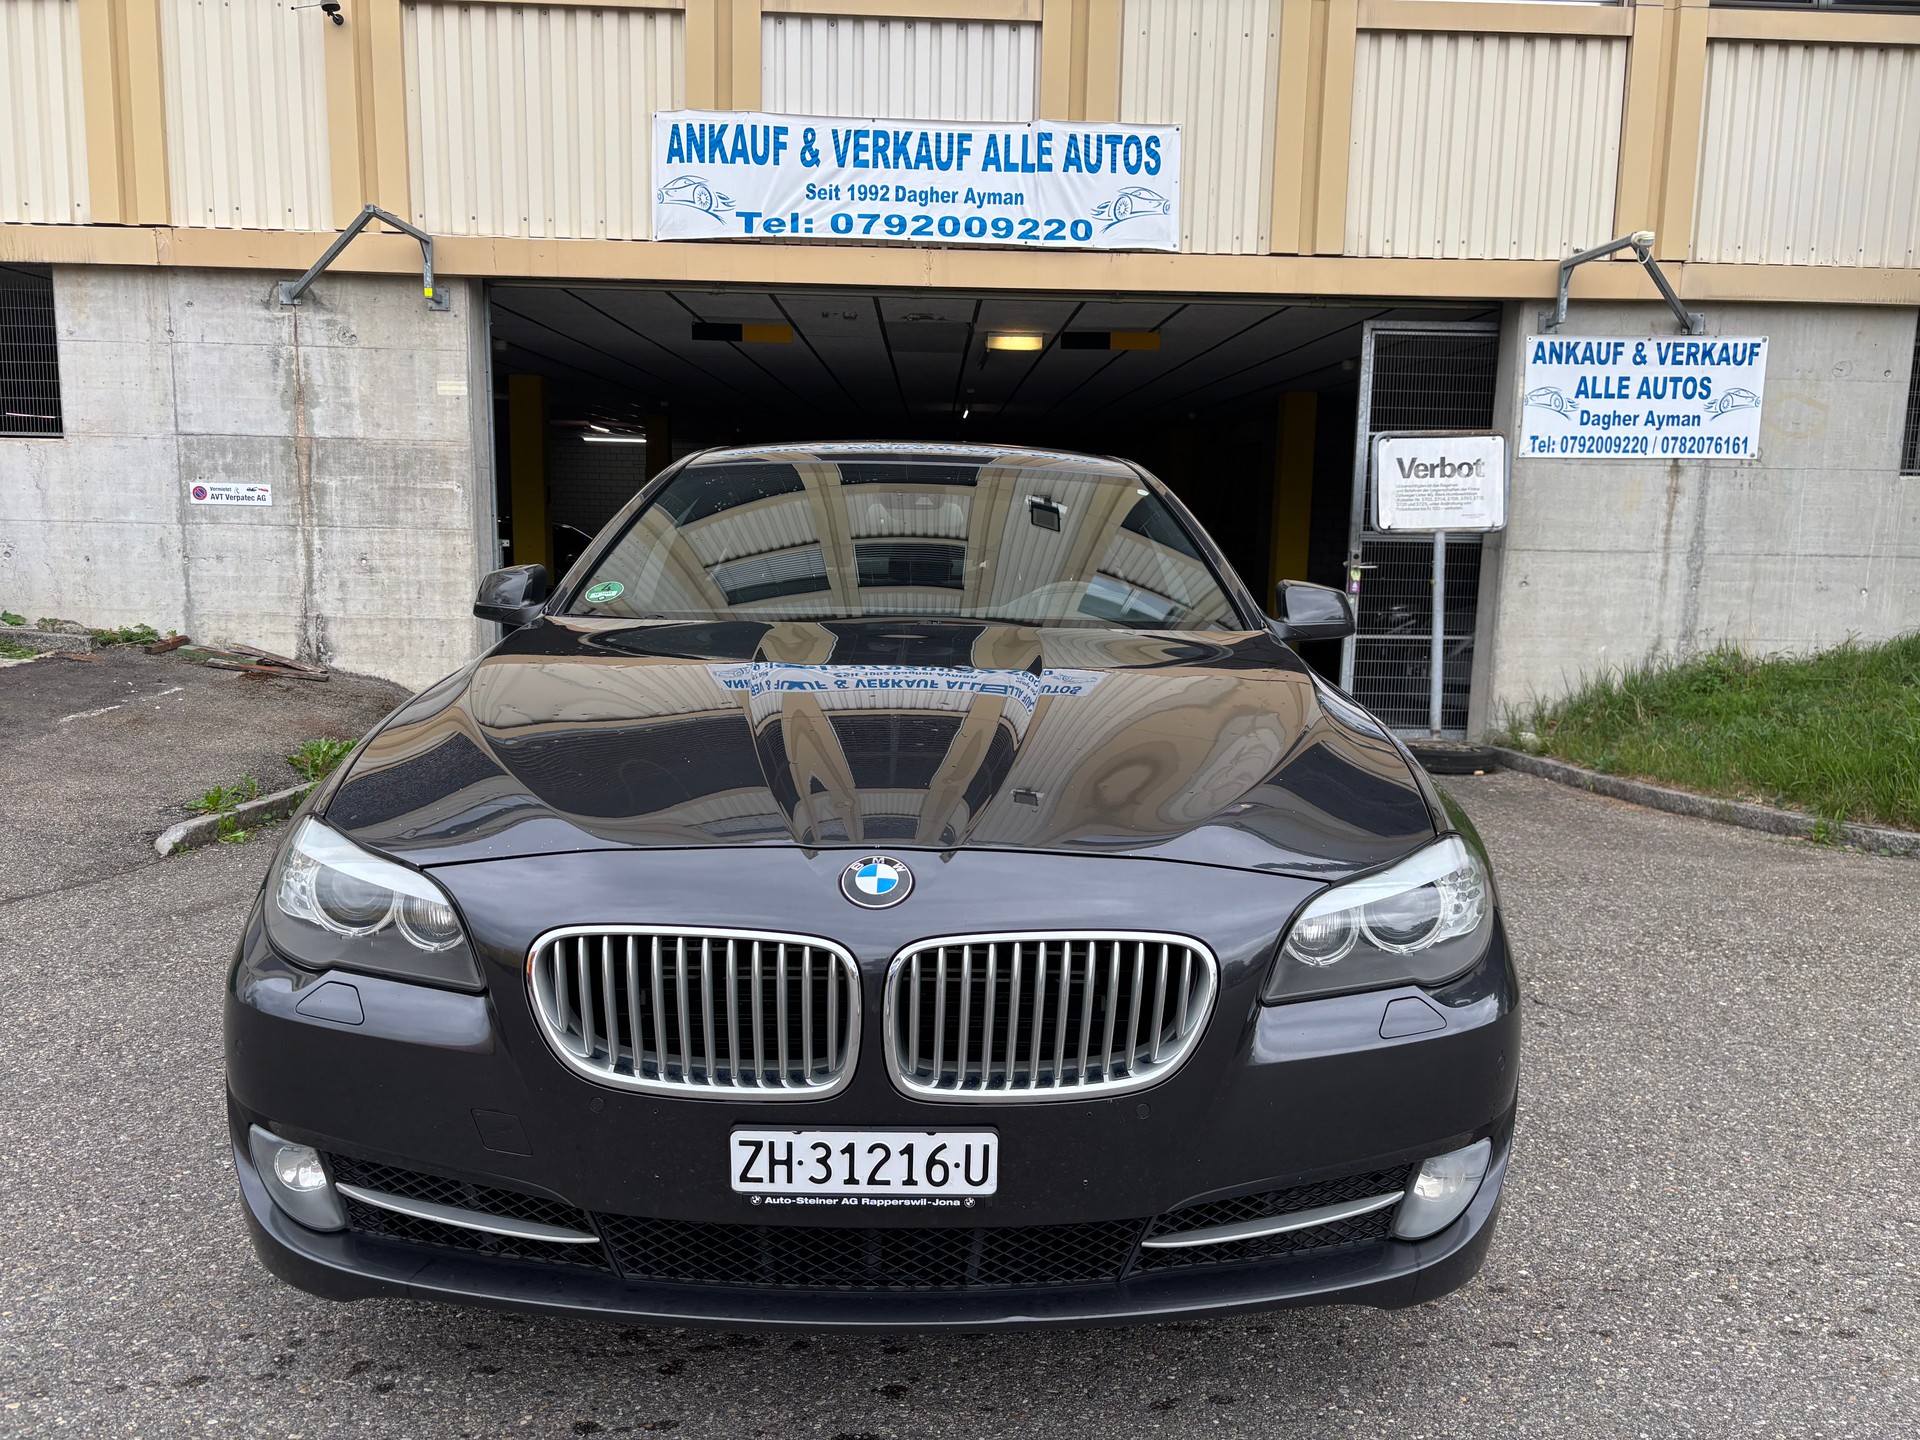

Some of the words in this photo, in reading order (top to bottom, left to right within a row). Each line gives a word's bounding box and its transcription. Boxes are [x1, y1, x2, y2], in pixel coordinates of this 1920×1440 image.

[666, 122, 789, 166] ANKAUF
[799, 127, 821, 168] &
[831, 128, 973, 172] VERKAUF
[981, 132, 1053, 174] ALLE
[1062, 133, 1161, 176] AUTOS
[805, 182, 841, 201] Seit
[847, 184, 890, 202] 1992
[895, 185, 959, 207] Dagher
[964, 187, 1024, 209] Ayman
[735, 211, 814, 234] Tel:
[830, 213, 1093, 242] 0792009220
[1532, 341, 1625, 365] ANKAUF
[1631, 341, 1648, 366] &
[1656, 342, 1761, 366] VERKAUF
[1574, 375, 1631, 399] ALLE
[1636, 376, 1712, 400] AUTOS
[1579, 409, 1639, 430] Dagher
[1644, 410, 1701, 430] Ayman
[1530, 435, 1556, 453] Tel:
[1560, 435, 1649, 454] 0792009220
[1652, 436, 1658, 454] /
[1661, 436, 1749, 454] 0782076161
[1396, 456, 1486, 479] Verbot
[210, 493, 224, 501] AVT
[225, 494, 255, 502] Verpatec
[850, 857, 907, 872] BMW
[764, 1196, 839, 1205] Auto-Steiner
[841, 1196, 859, 1206] AG
[861, 1197, 961, 1207] Rapperswil-Jona
